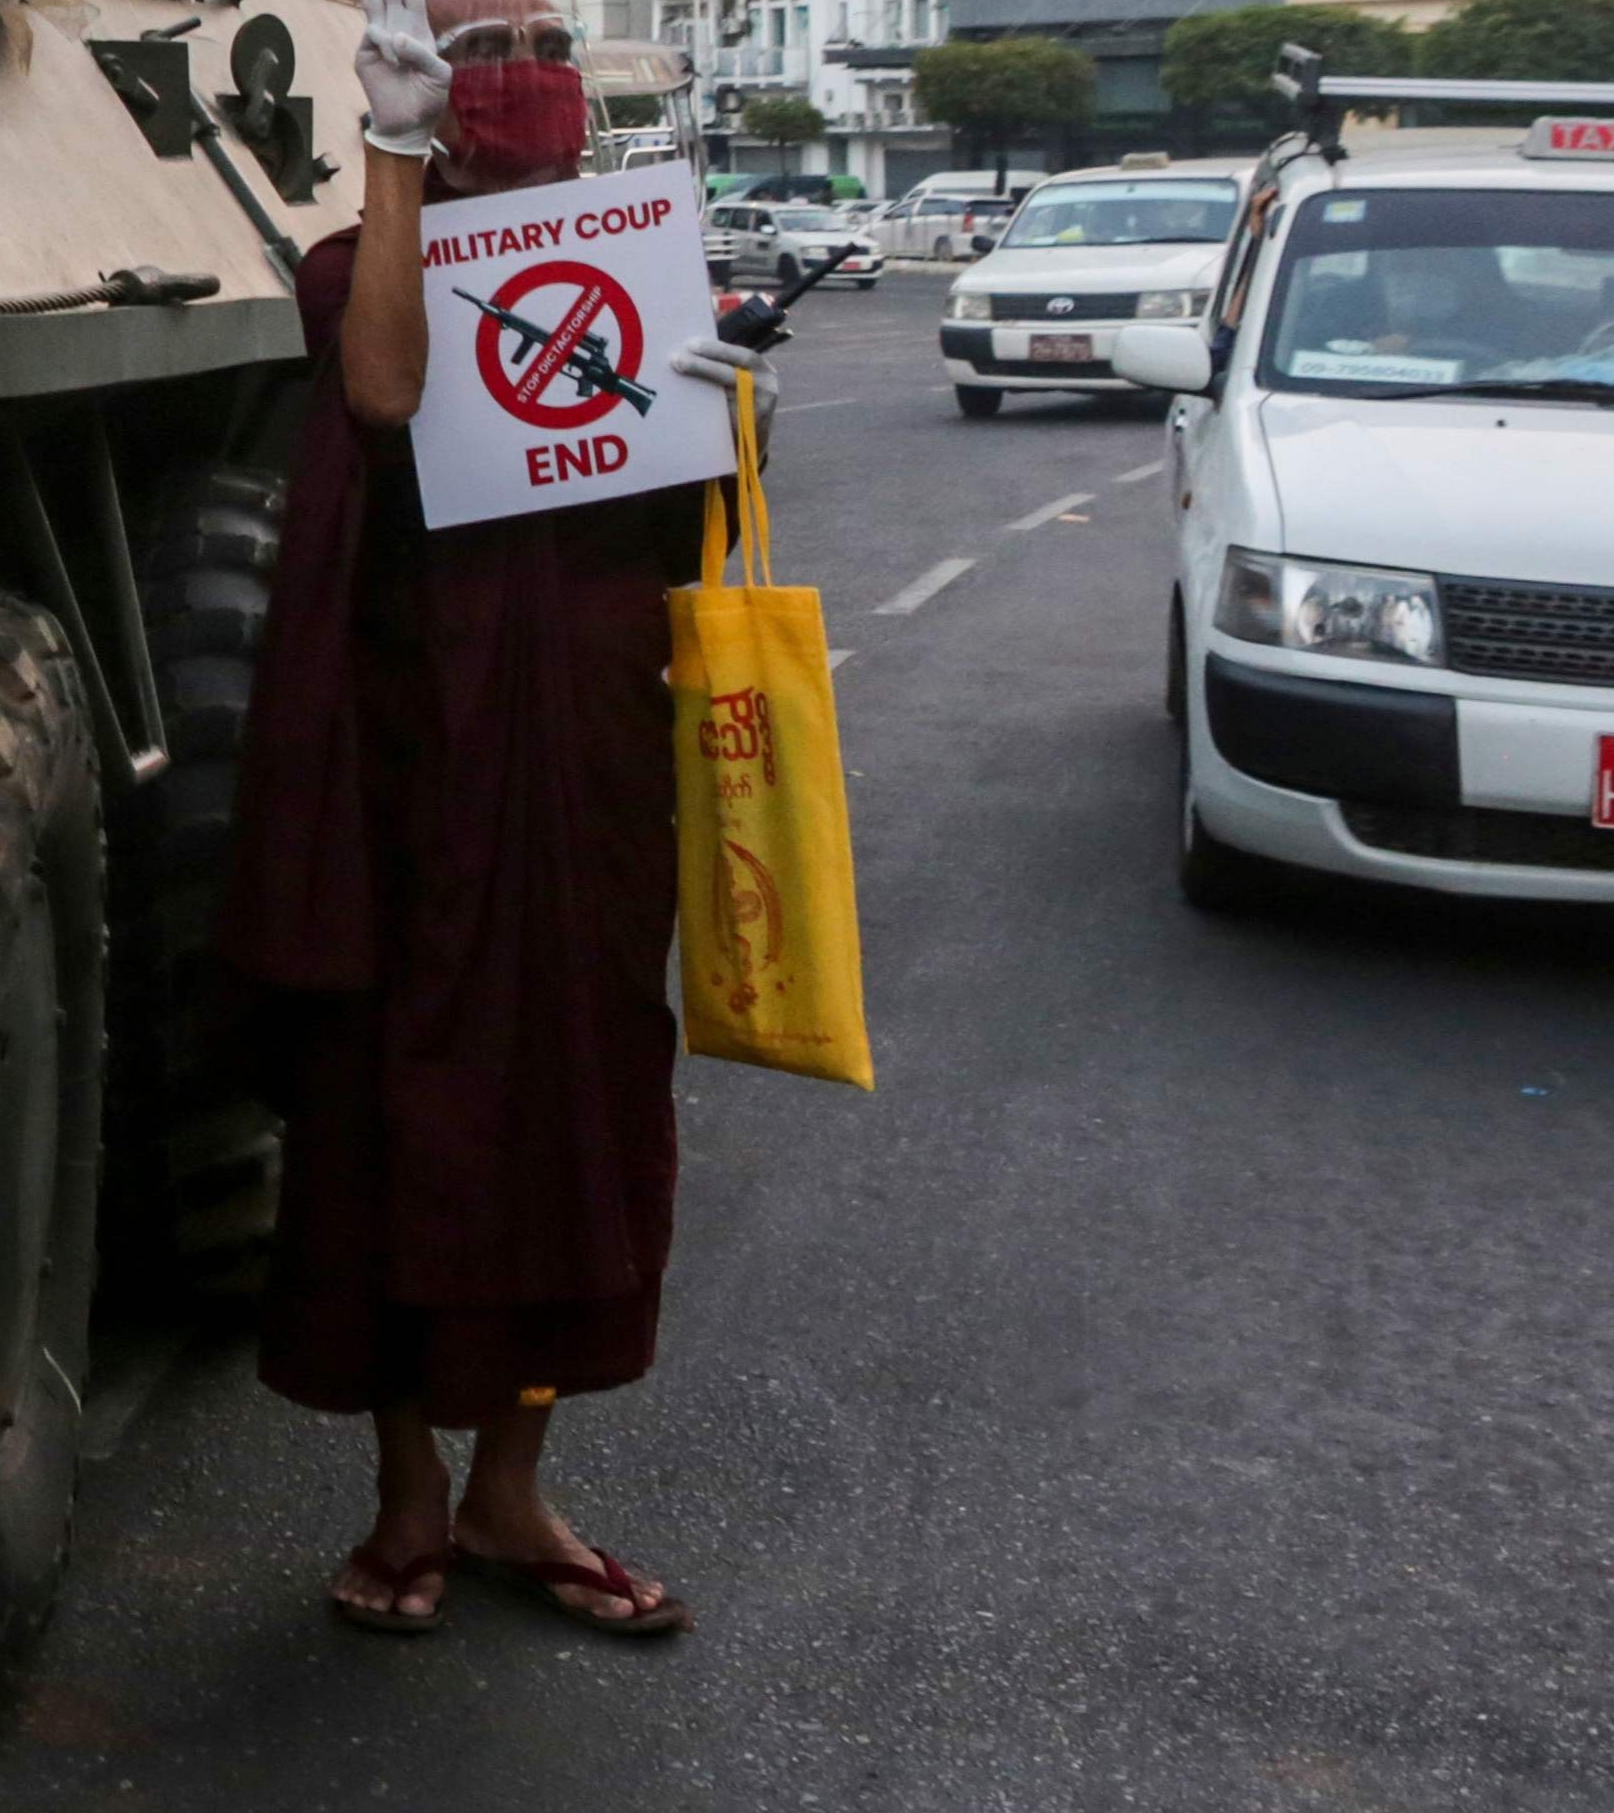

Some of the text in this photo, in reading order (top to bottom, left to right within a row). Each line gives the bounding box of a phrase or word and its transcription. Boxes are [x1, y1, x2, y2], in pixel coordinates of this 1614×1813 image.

[422, 198, 672, 269] MILITARY COUP
[516, 371, 541, 404] STOP
[525, 434, 629, 487] END
